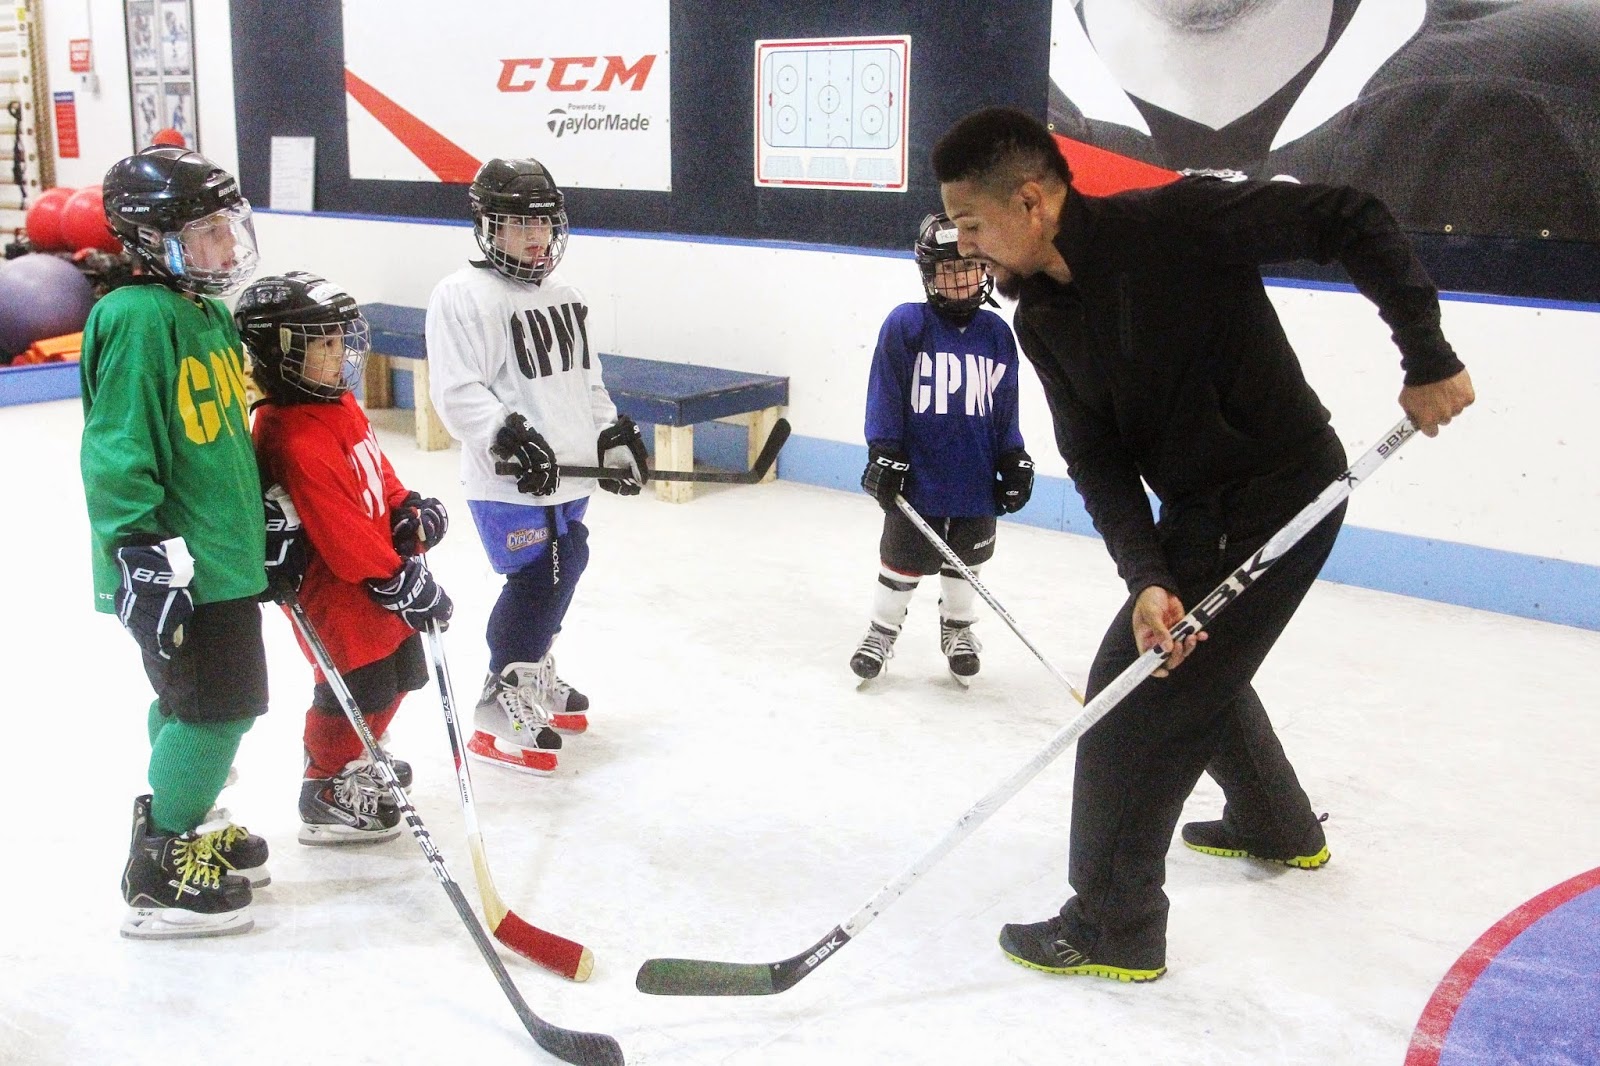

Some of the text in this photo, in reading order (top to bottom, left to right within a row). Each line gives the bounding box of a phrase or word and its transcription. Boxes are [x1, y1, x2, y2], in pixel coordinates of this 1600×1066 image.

[496, 54, 657, 92] CCM
[547, 108, 650, 138] TaylorMade
[567, 103, 606, 112] Powered by
[510, 302, 591, 380] CPNY
[177, 347, 249, 445] CPN
[910, 351, 1007, 417] CPNY
[1376, 424, 1409, 456] SBK
[508, 528, 549, 547] CYCLONES
[552, 539, 560, 585] TACKLA
[804, 935, 844, 968] SBK
